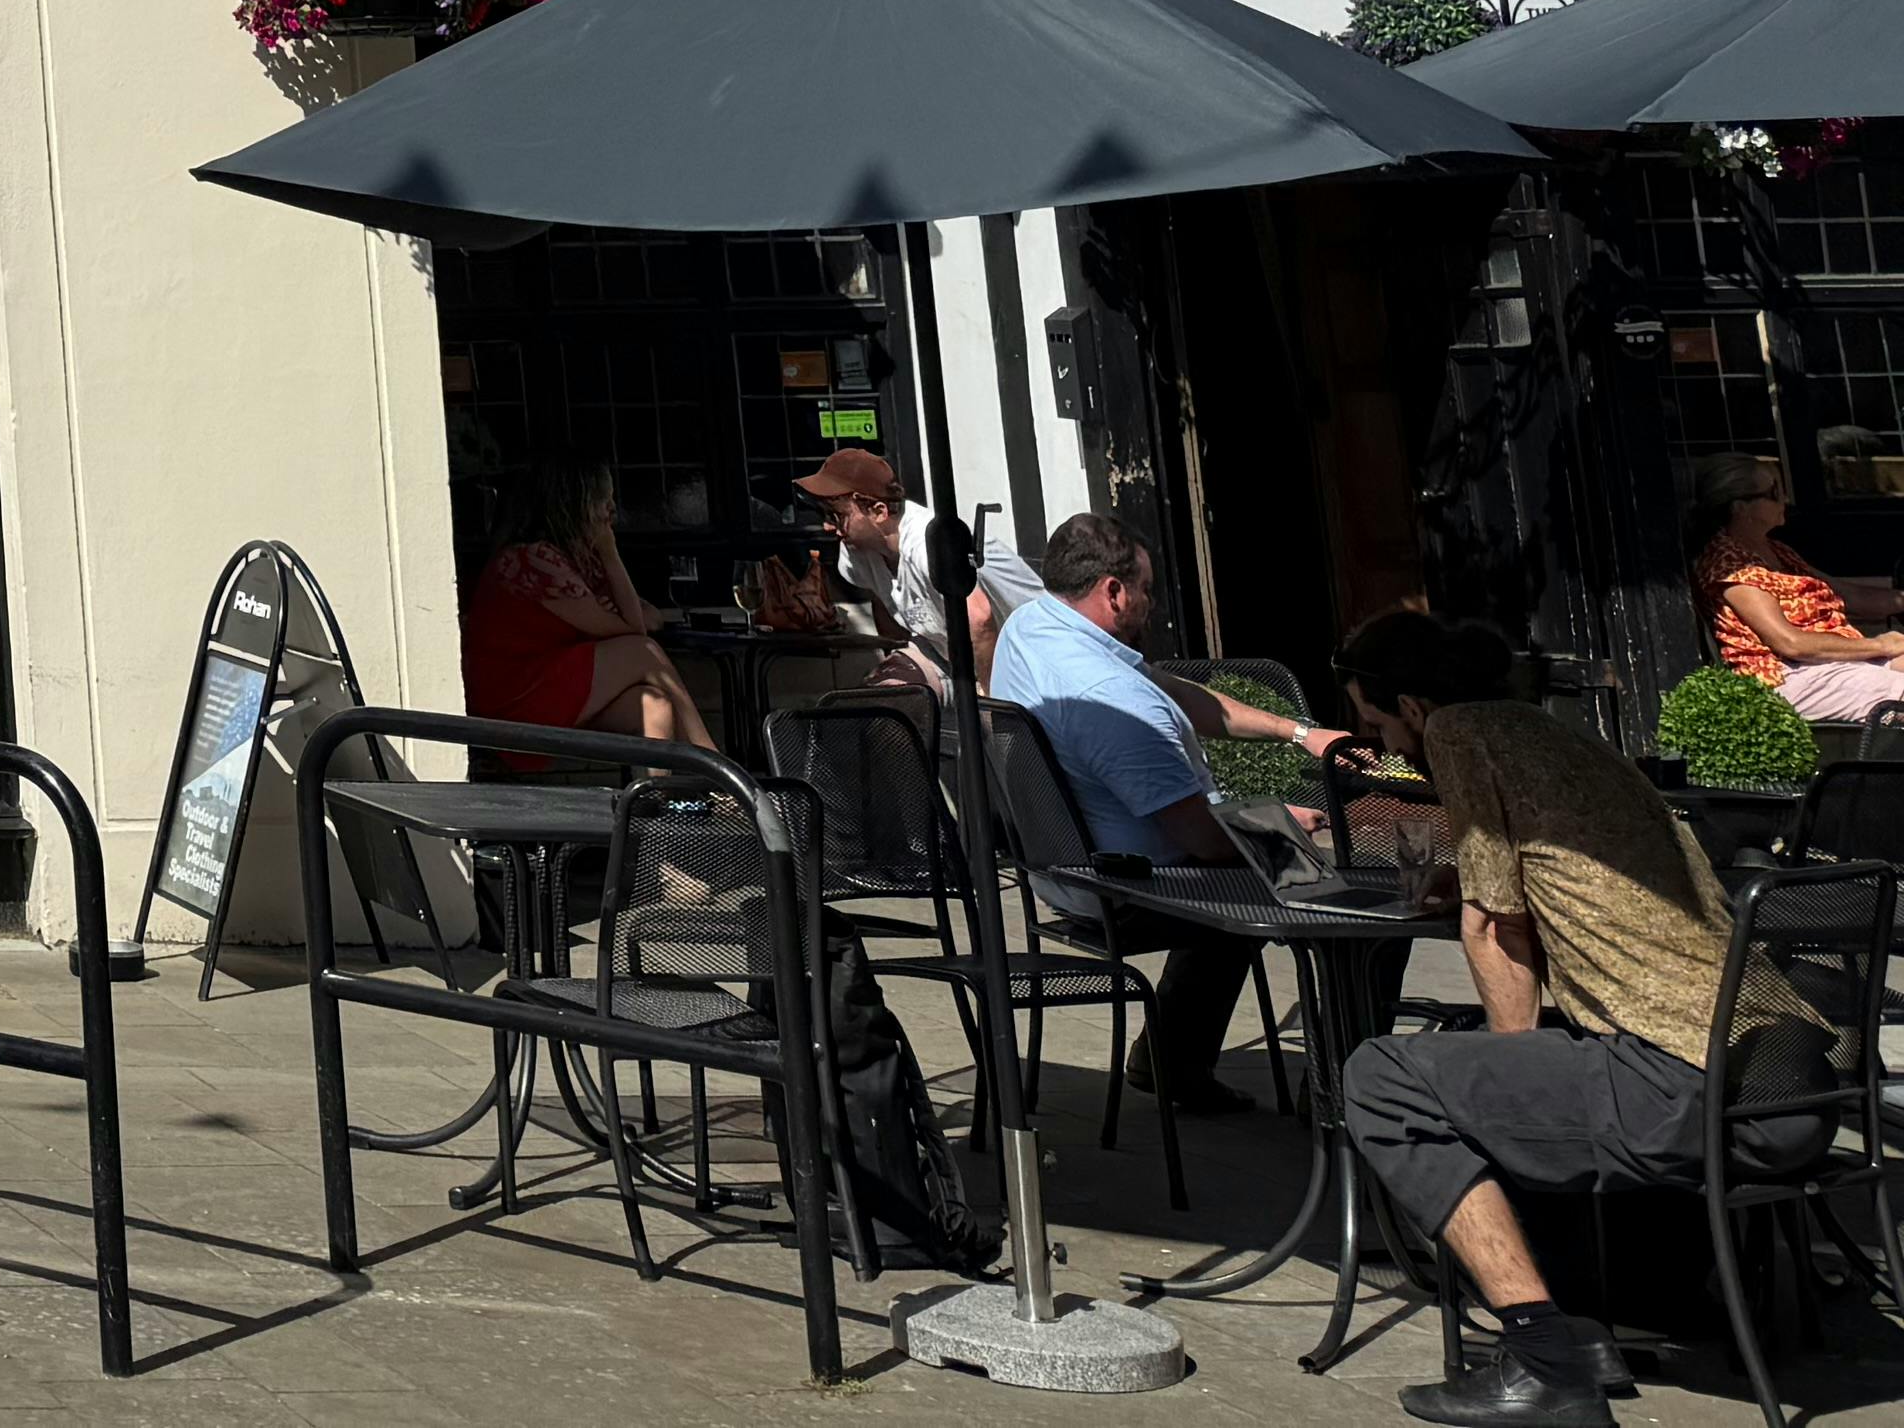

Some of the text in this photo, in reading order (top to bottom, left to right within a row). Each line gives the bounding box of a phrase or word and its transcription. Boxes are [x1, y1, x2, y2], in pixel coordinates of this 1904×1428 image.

[233, 590, 272, 619] Rohan
[182, 799, 229, 834] Outdoor &
[185, 821, 215, 850] Travel
[168, 857, 221, 896] Specialists
[185, 844, 225, 880] Clothing
